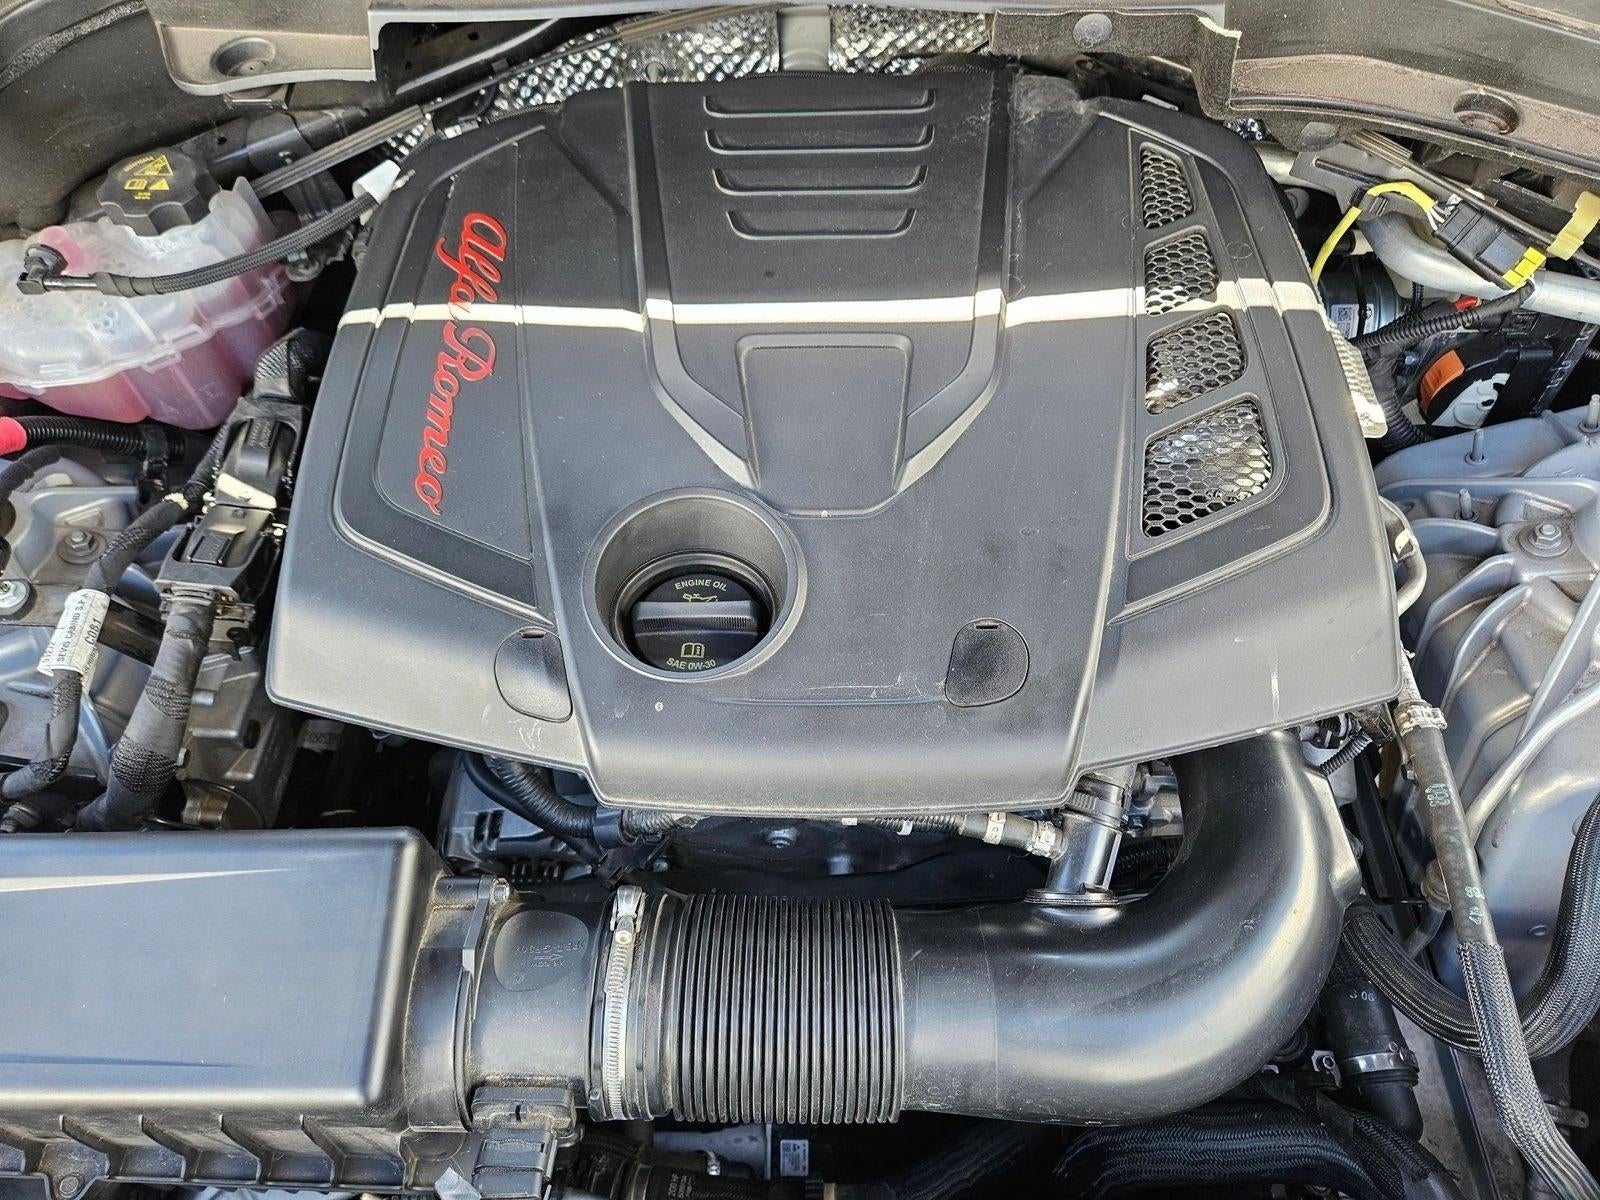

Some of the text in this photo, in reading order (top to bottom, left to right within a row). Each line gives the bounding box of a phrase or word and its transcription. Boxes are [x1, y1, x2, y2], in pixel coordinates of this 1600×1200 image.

[414, 213, 508, 516] Alfa Romeo
[674, 579, 727, 592] ENGINE OIL
[666, 657, 687, 669] SAE
